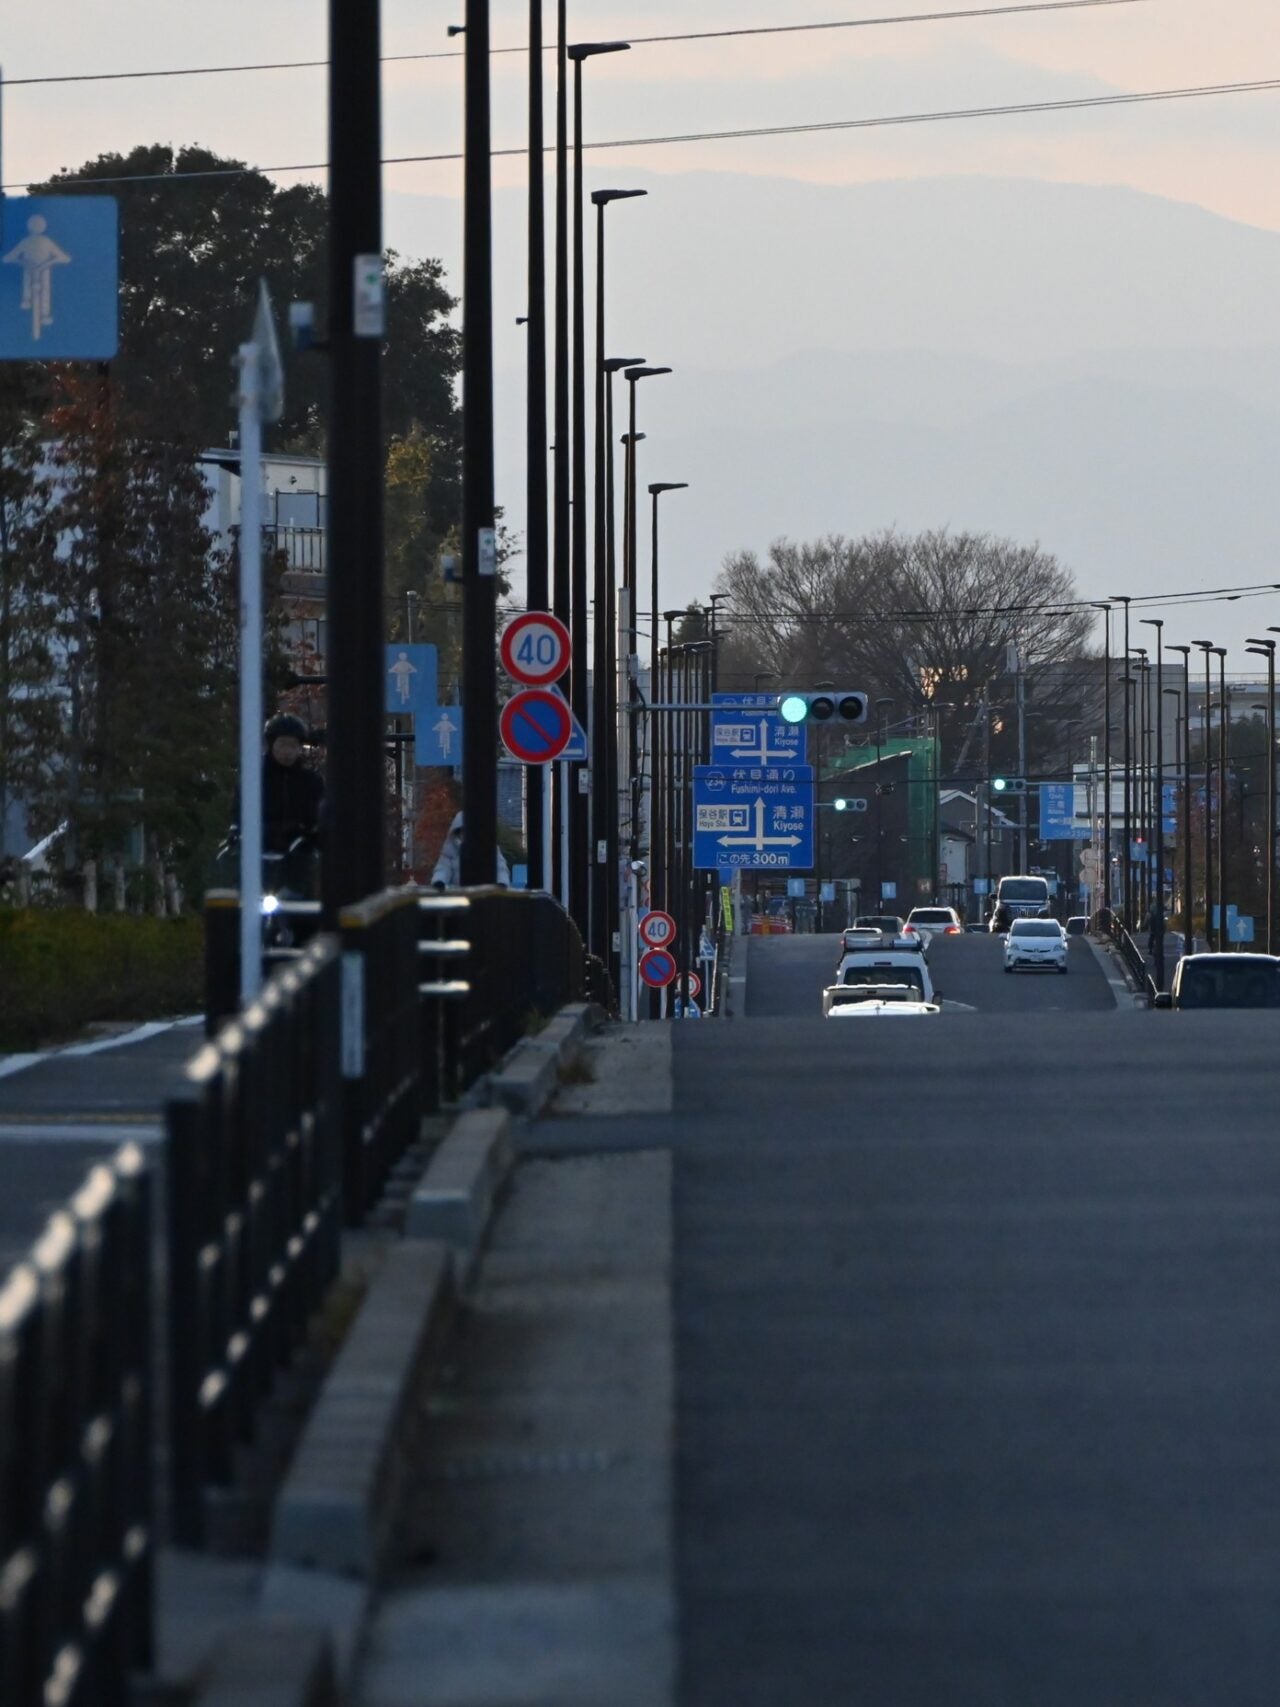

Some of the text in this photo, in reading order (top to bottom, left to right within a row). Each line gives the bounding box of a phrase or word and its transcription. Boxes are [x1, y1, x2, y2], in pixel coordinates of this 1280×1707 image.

[517, 634, 555, 665] 40
[774, 737, 799, 747] Kiyose
[731, 783, 779, 795] Fushimi-dori
[773, 820, 804, 833] Kiyose
[648, 921, 667, 938] 40
